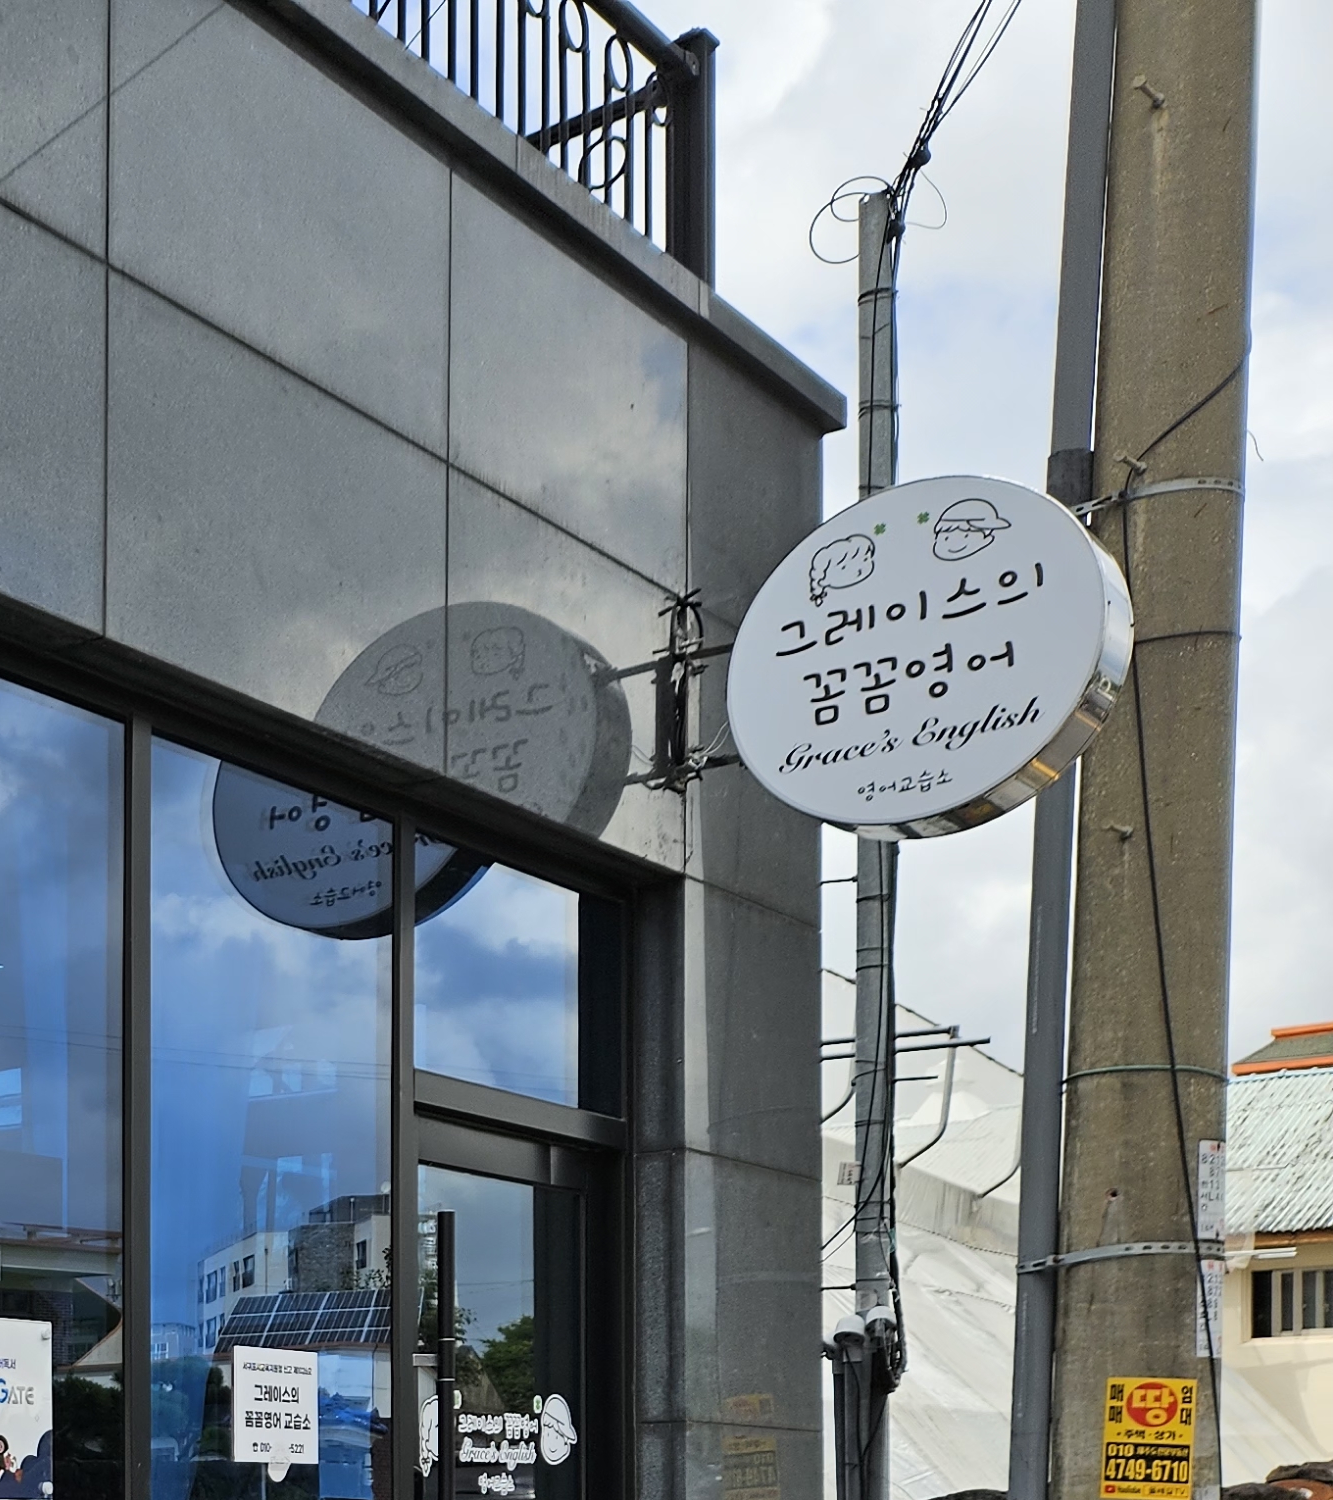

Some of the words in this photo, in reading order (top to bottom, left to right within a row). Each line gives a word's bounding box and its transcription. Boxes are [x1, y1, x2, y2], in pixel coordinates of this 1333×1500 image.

[776, 562, 1043, 656] 그레이스의
[803, 641, 1015, 725] 꼼꼼영어
[779, 730, 902, 774] Grace's
[912, 696, 1045, 750] English
[857, 770, 952, 800] 영어교습소
[254, 1384, 299, 1403] 그레이스의
[1108, 1384, 1124, 1423] 매매
[1131, 1386, 1175, 1425] 땅
[1180, 1385, 1193, 1426] 임대
[245, 1411, 281, 1429] 꼼꼼영어
[284, 1413, 311, 1430] 교습소
[504, 1413, 538, 1439] 꼼꼼영어
[459, 1436, 499, 1462] Grace's
[499, 1440, 537, 1471] English
[1108, 1443, 1134, 1457] 010
[1106, 1459, 1188, 1482] 4749-6710
